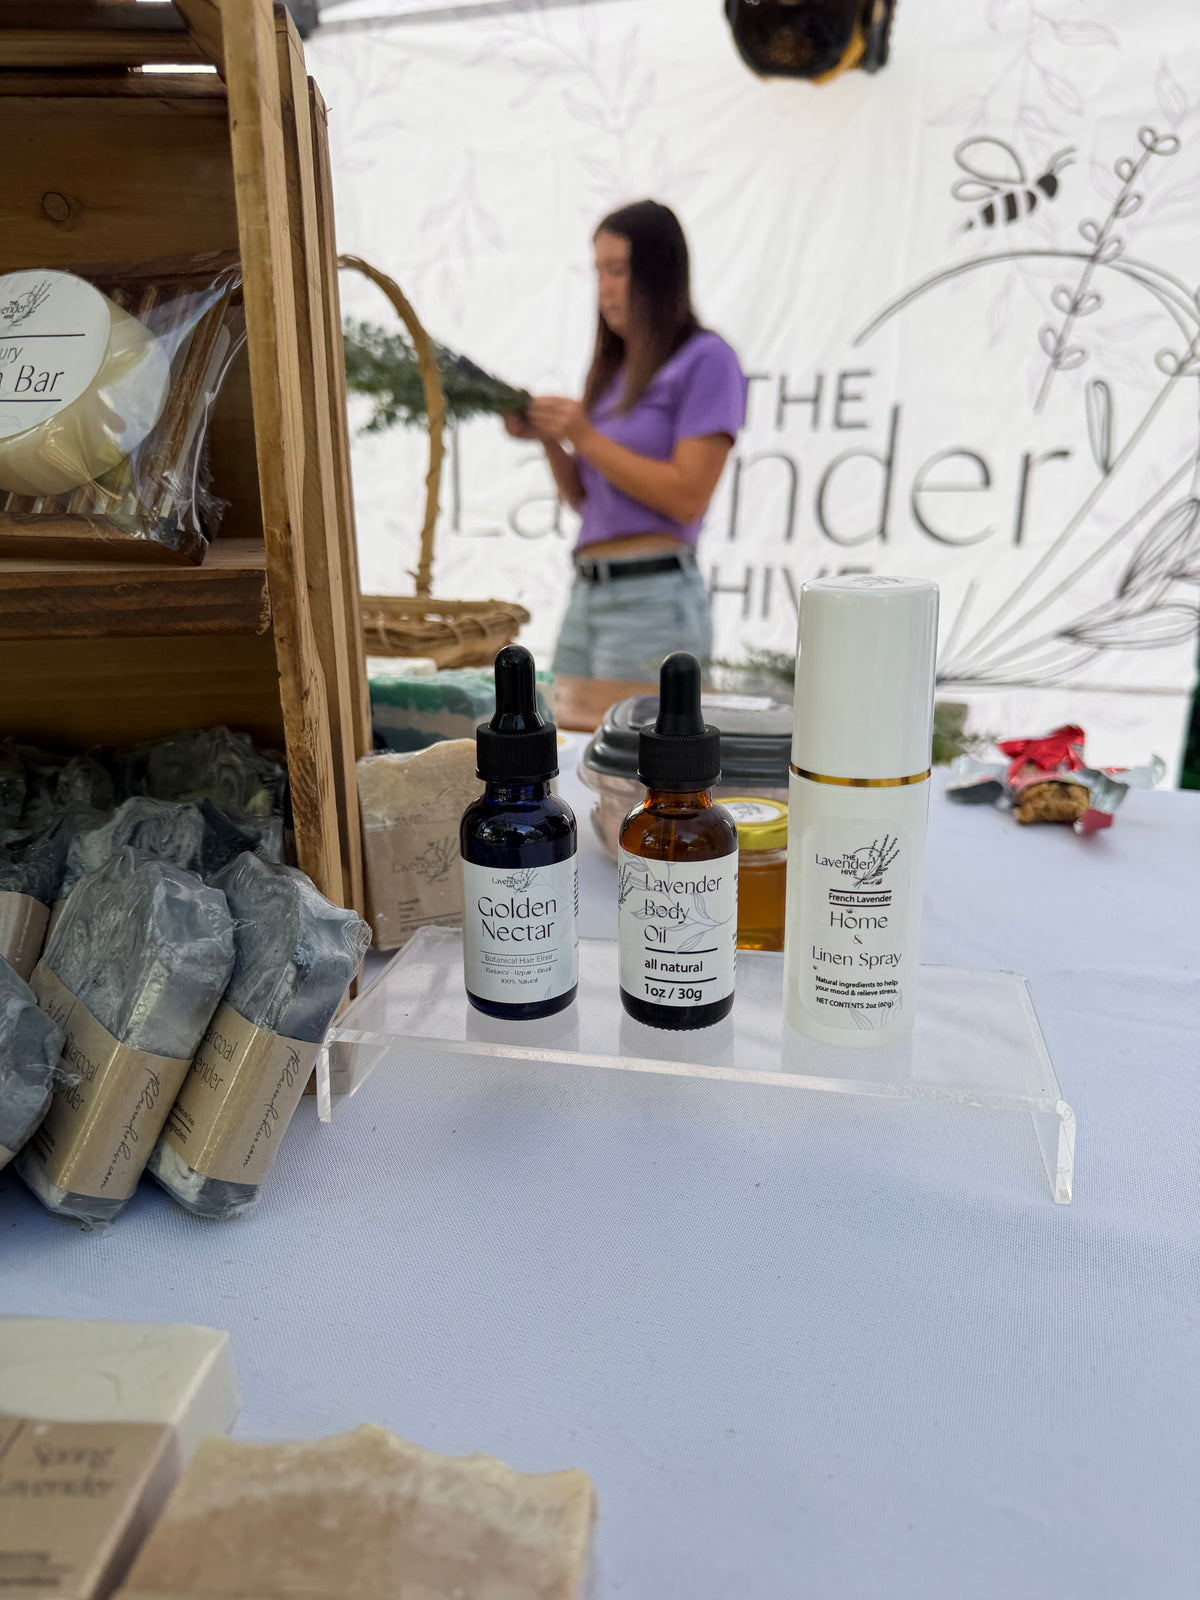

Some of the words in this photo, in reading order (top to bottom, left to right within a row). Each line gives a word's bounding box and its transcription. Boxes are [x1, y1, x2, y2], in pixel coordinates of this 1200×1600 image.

[0, 346, 23, 363] ury
[14, 364, 64, 393] Bar
[742, 368, 873, 432] THE
[452, 401, 1071, 547] Lander
[815, 853, 872, 870] Lavender
[645, 873, 722, 894] Lavender
[477, 896, 557, 919] Golden
[828, 892, 855, 903] French
[857, 894, 892, 903] Lavender
[644, 899, 690, 924] Body
[830, 911, 888, 929] Home
[481, 918, 555, 941] Nectar
[644, 924, 666, 943] Oil
[852, 934, 863, 944] &
[484, 953, 518, 964] Botanical
[519, 956, 535, 964] Hair
[536, 954, 553, 963] Elixir
[644, 958, 657, 970] all
[660, 961, 703, 973] natural
[812, 945, 853, 966] Linen
[858, 952, 902, 970] Spray
[815, 975, 838, 986] Natural
[838, 980, 876, 988] ingredients
[876, 979, 883, 987] to
[883, 979, 899, 988] help
[815, 984, 829, 992] your
[830, 988, 849, 996] mood
[644, 983, 666, 998] 1oz
[668, 987, 675, 999] /
[677, 988, 703, 1001] 30g
[816, 996, 828, 1005] NET
[829, 999, 865, 1009] CONTENTS
[878, 1000, 894, 1009] (60g)
[203, 1027, 239, 1063] arcoal
[193, 1056, 224, 1092] ender
[243, 1044, 301, 1169] thelavenderhivecom
[100, 1067, 161, 1190] thelavenderhivecom
